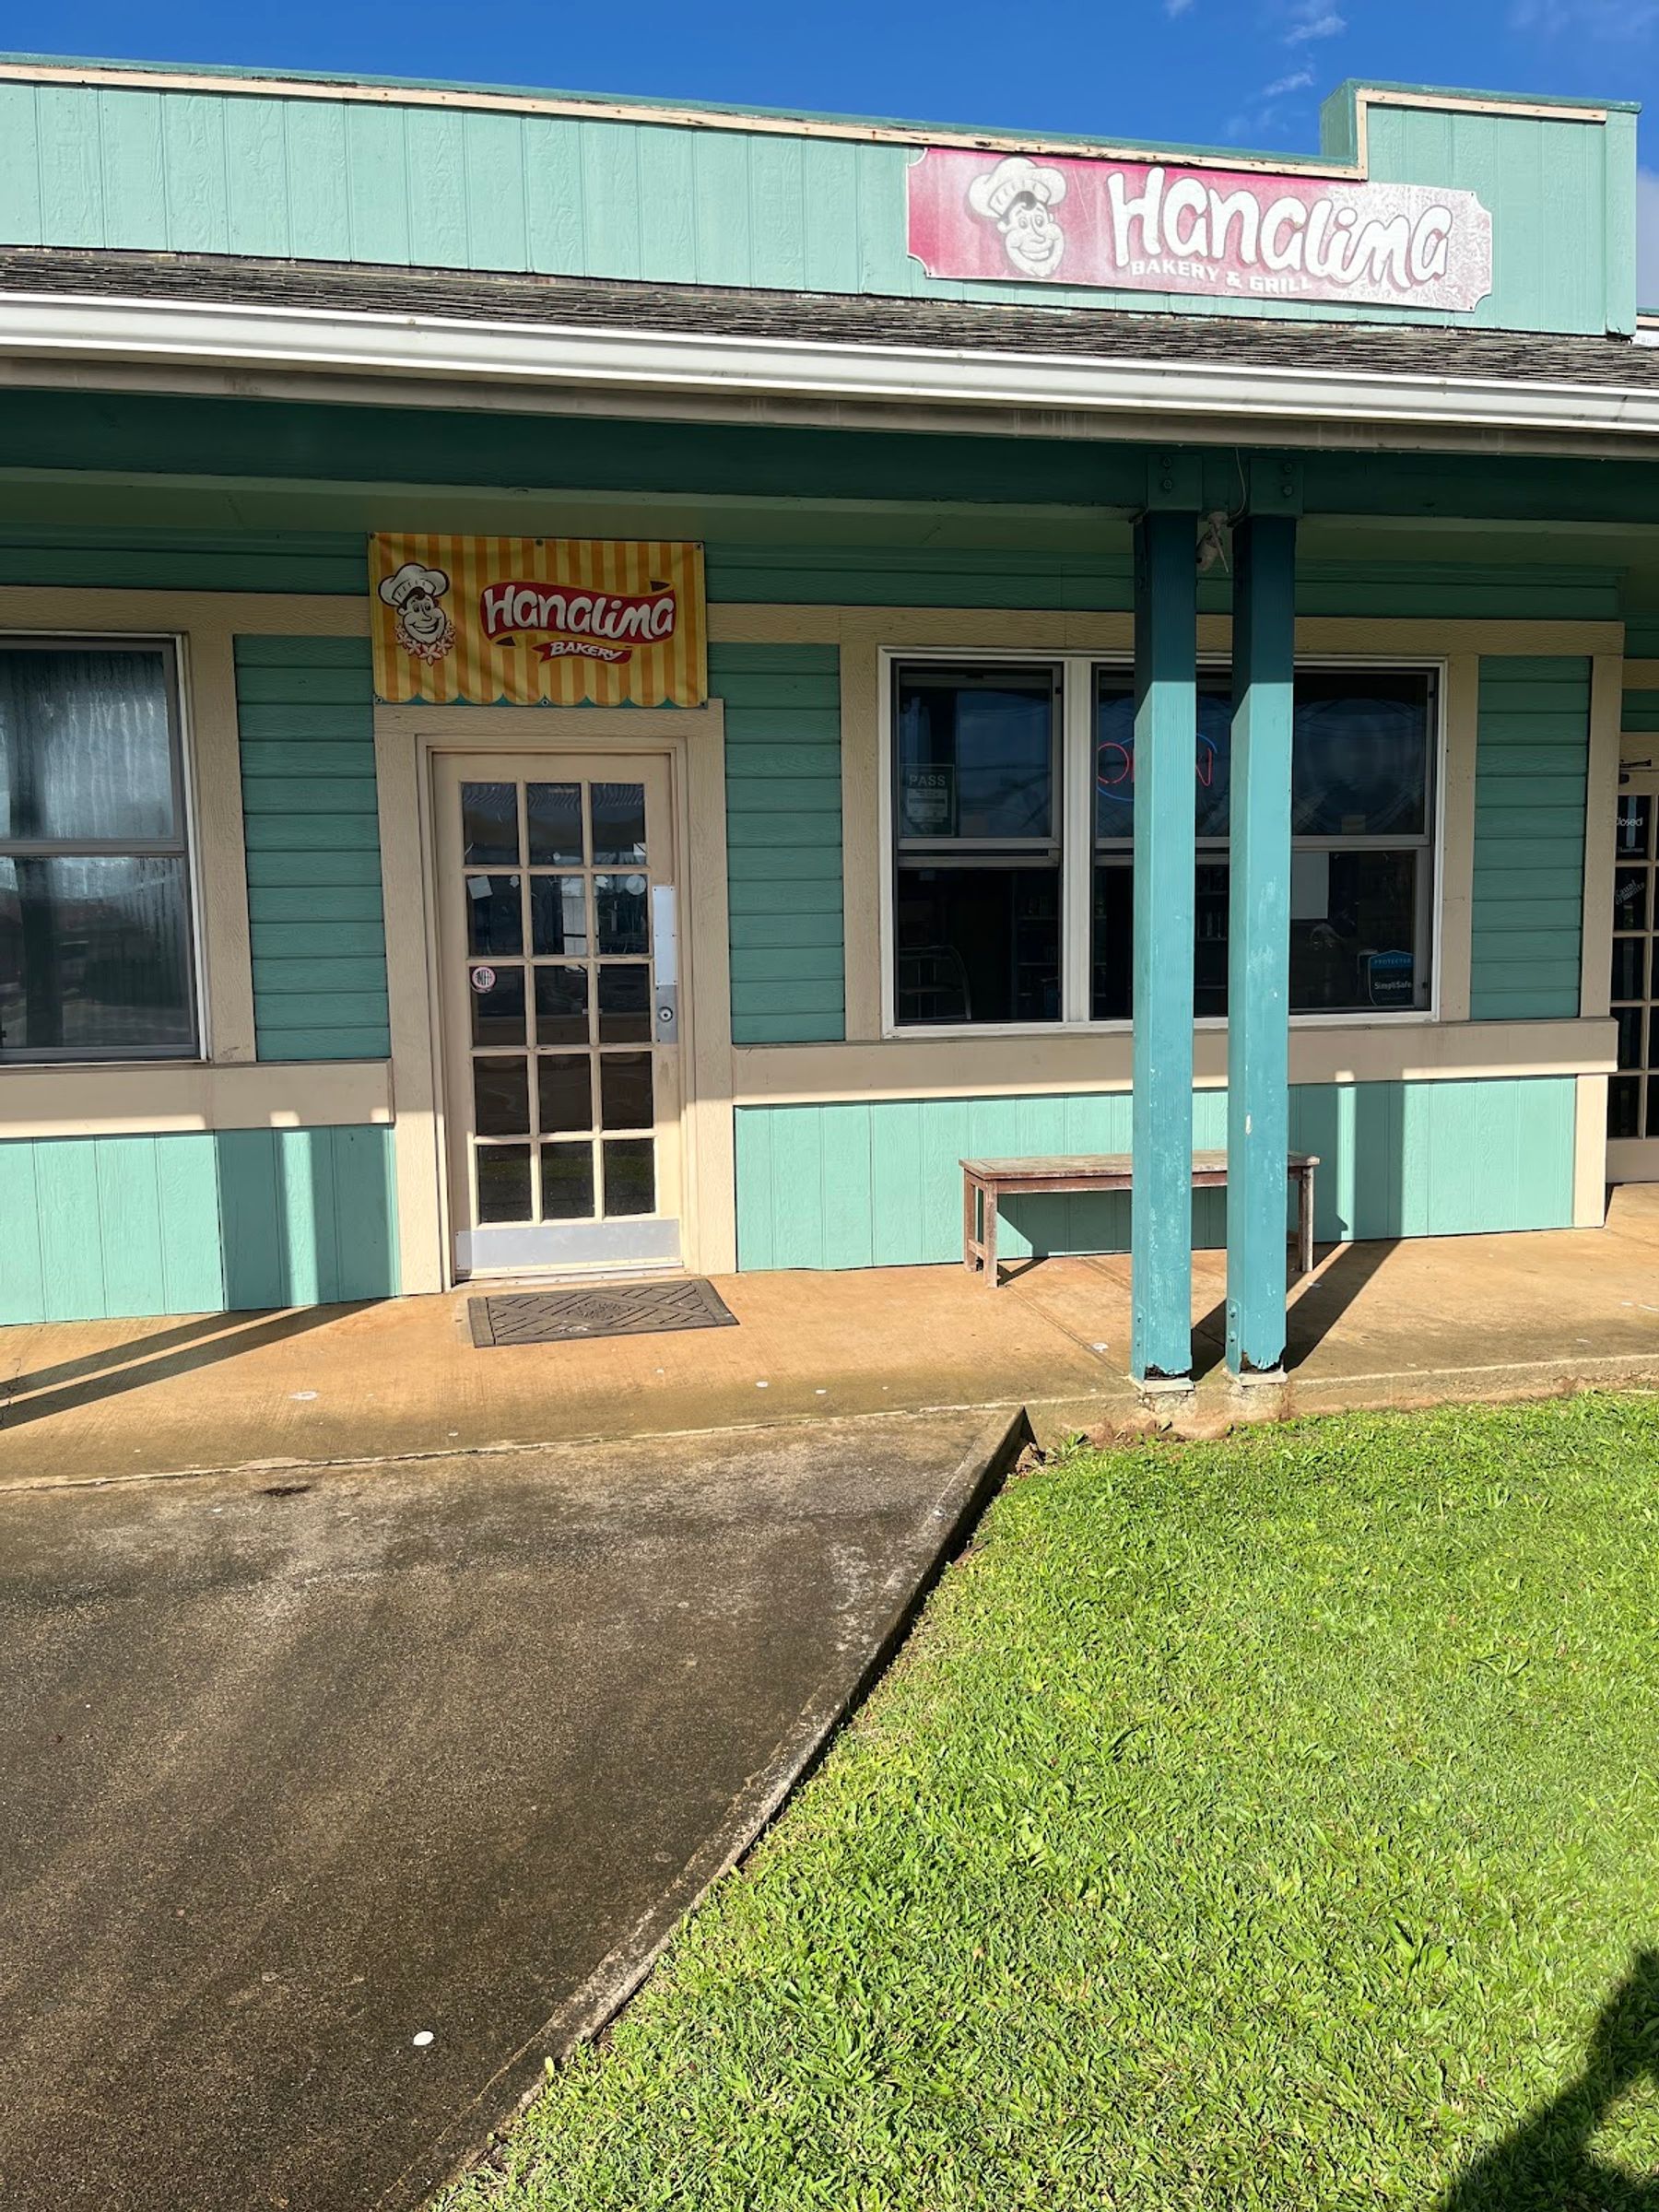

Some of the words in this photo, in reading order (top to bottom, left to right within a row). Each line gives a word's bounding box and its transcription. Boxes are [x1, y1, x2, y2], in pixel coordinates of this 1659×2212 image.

[1107, 167, 1453, 288] Hanalima
[1132, 260, 1219, 282] BAKERY
[1227, 272, 1242, 288] &
[1250, 277, 1312, 294] GRILL
[484, 584, 674, 640] Hanalima
[550, 641, 624, 661] BAKERY
[909, 774, 946, 786] PASS
[1097, 742, 1213, 786] ON
